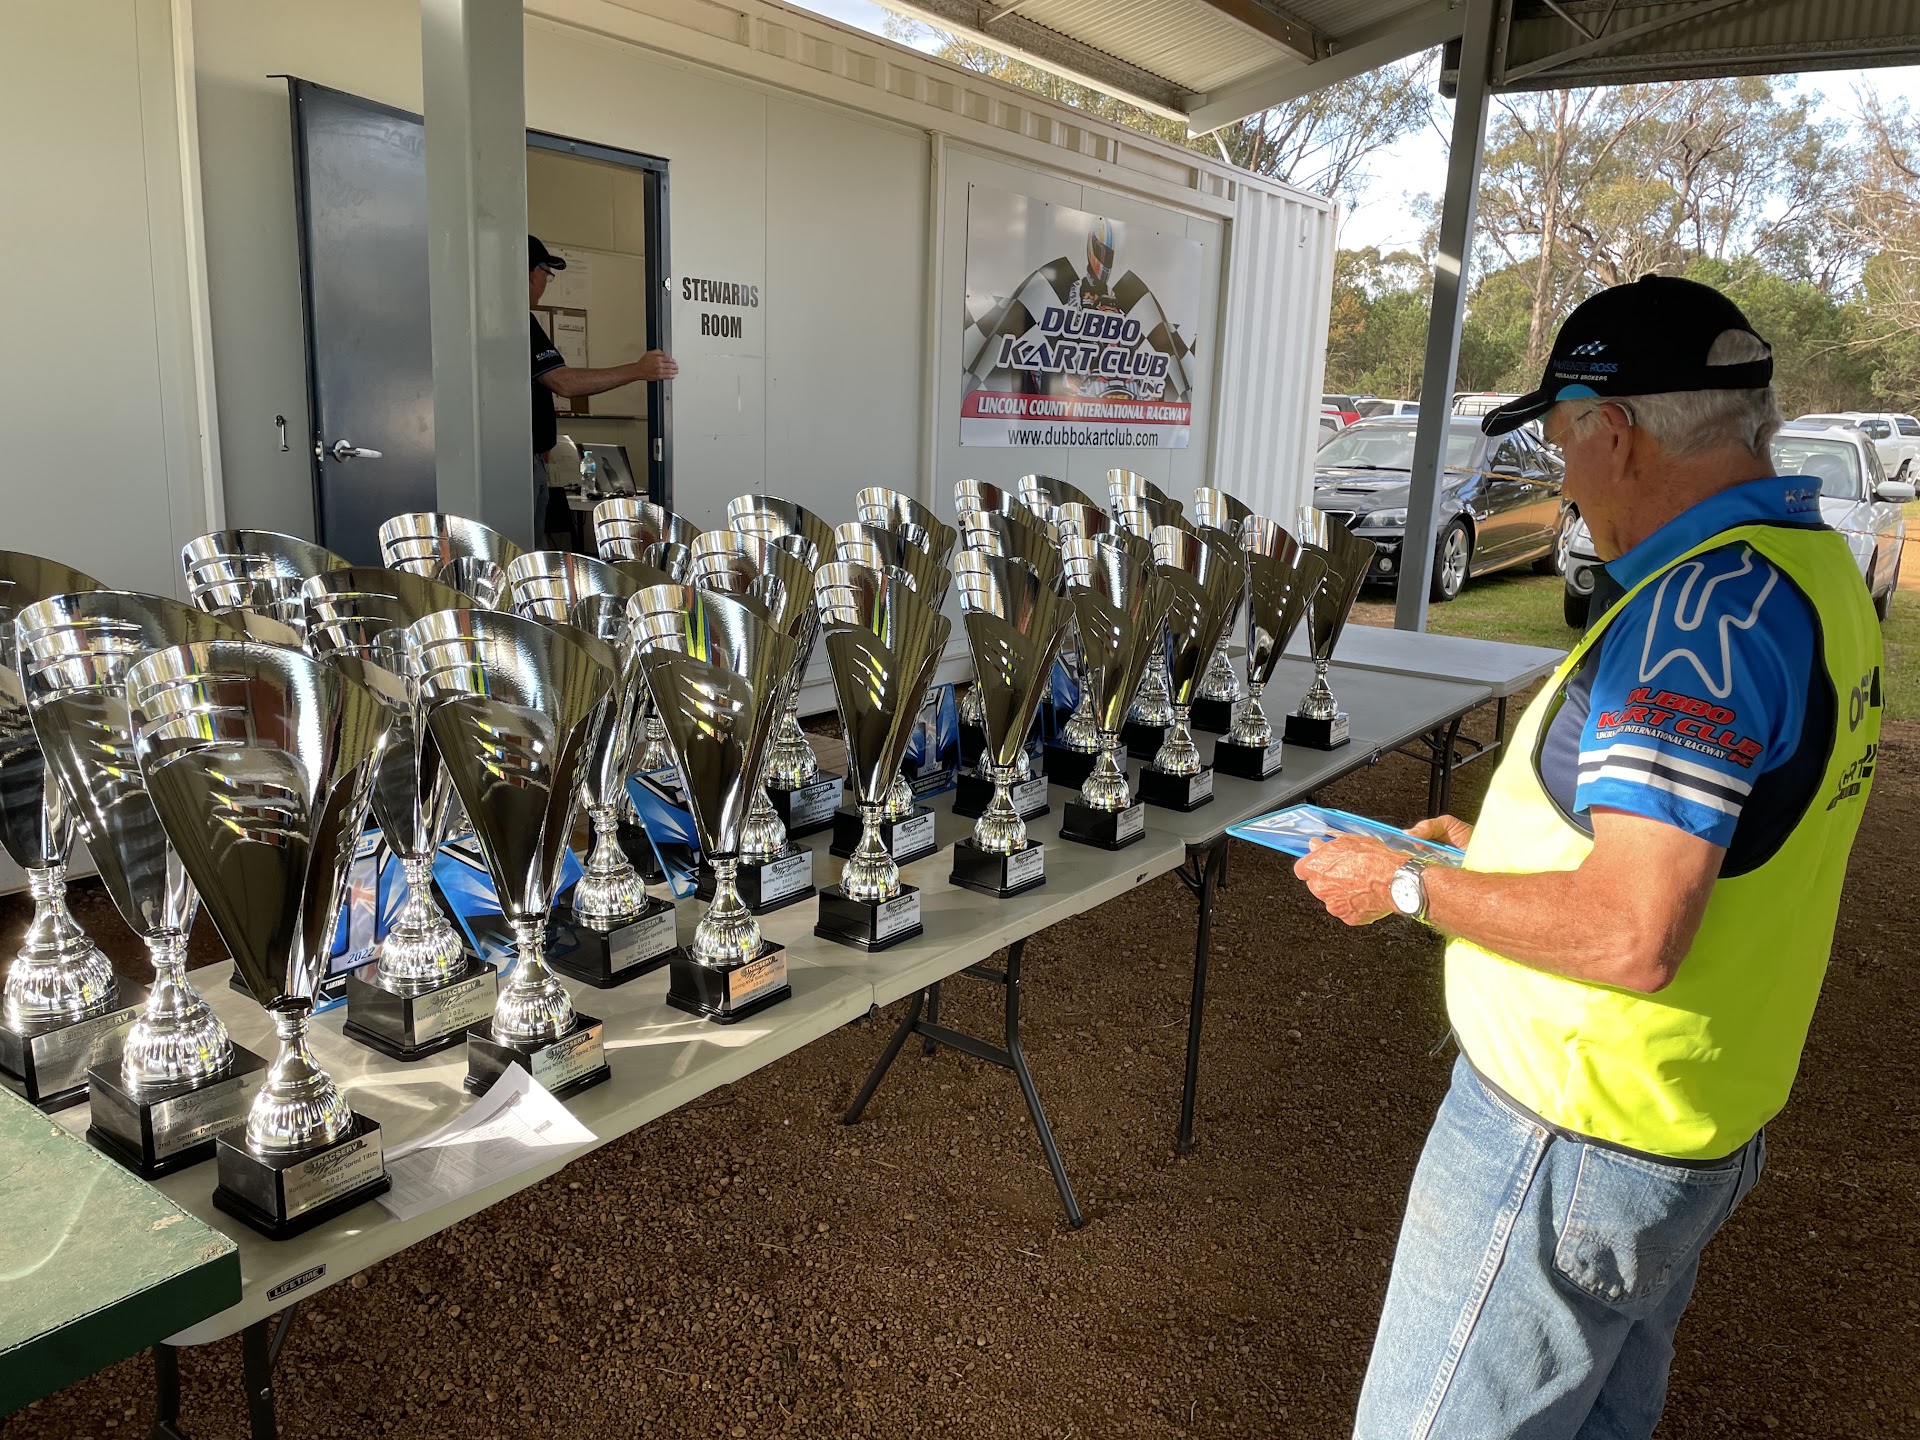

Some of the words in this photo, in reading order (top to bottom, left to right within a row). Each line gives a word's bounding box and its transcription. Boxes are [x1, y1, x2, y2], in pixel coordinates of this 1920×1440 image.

[682, 277, 759, 308] STEWARDS
[701, 313, 742, 338] ROOM
[1040, 306, 1141, 343] DUBBO
[998, 338, 1098, 372] KART
[1100, 350, 1169, 378] CLUB
[1590, 362, 1618, 373] ROSS
[1141, 382, 1164, 395] INC
[977, 396, 1027, 415] LINCOLN
[1029, 399, 1071, 417] COUNTY
[1072, 401, 1144, 420] INTERNATIONAL
[1146, 405, 1189, 422] RACEWAY
[1008, 426, 1159, 446] www.dubbokartclub.com
[1624, 724, 1684, 746] INTERNATIONAL
[1684, 739, 1727, 759] RACEWAY
[1675, 718, 1764, 757] CLUB
[347, 946, 376, 964] 2022
[437, 982, 476, 1000] TRACSERV
[551, 1035, 585, 1055] TRACSERV
[157, 1140, 171, 1149] 2nd
[176, 1130, 199, 1142] Senior
[200, 1115, 244, 1134] Performance
[312, 1142, 358, 1168] TRACSERV
[344, 1157, 362, 1170] Sprint
[362, 1150, 379, 1160] Titles
[274, 1269, 321, 1296] LIFETIME
